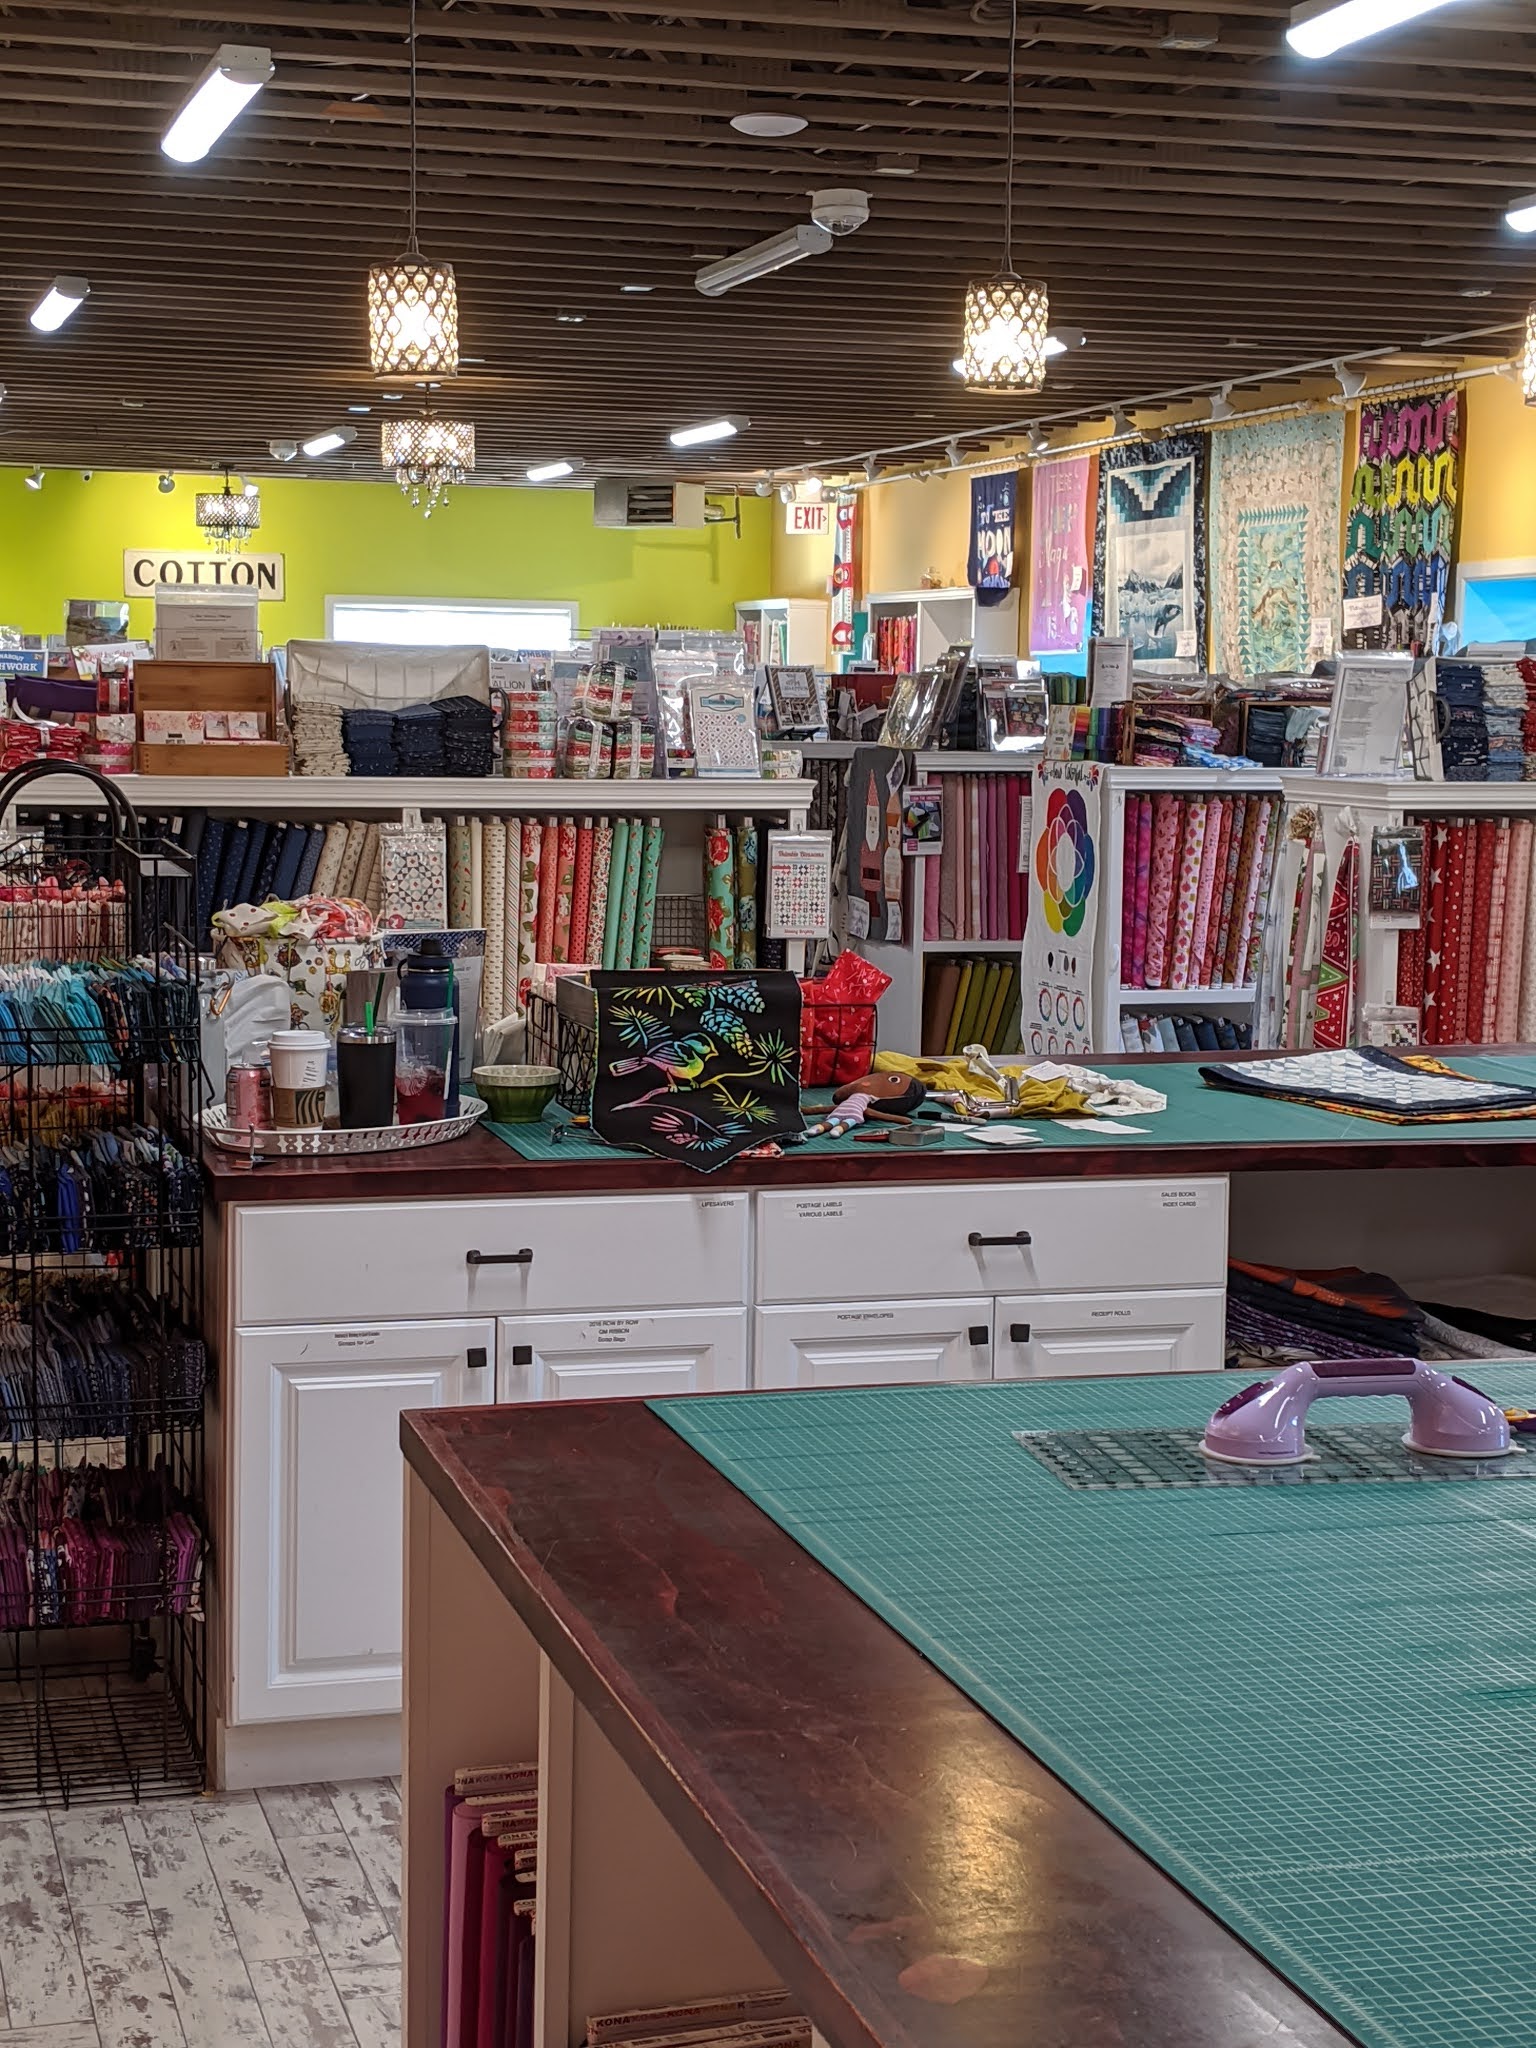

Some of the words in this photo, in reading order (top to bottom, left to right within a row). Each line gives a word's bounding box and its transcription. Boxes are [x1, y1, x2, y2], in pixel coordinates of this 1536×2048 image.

[794, 506, 824, 530] EXIT
[133, 558, 276, 590] COTTON
[492, 680, 526, 690] ALLION
[701, 1200, 735, 1208] LIFESAVERS
